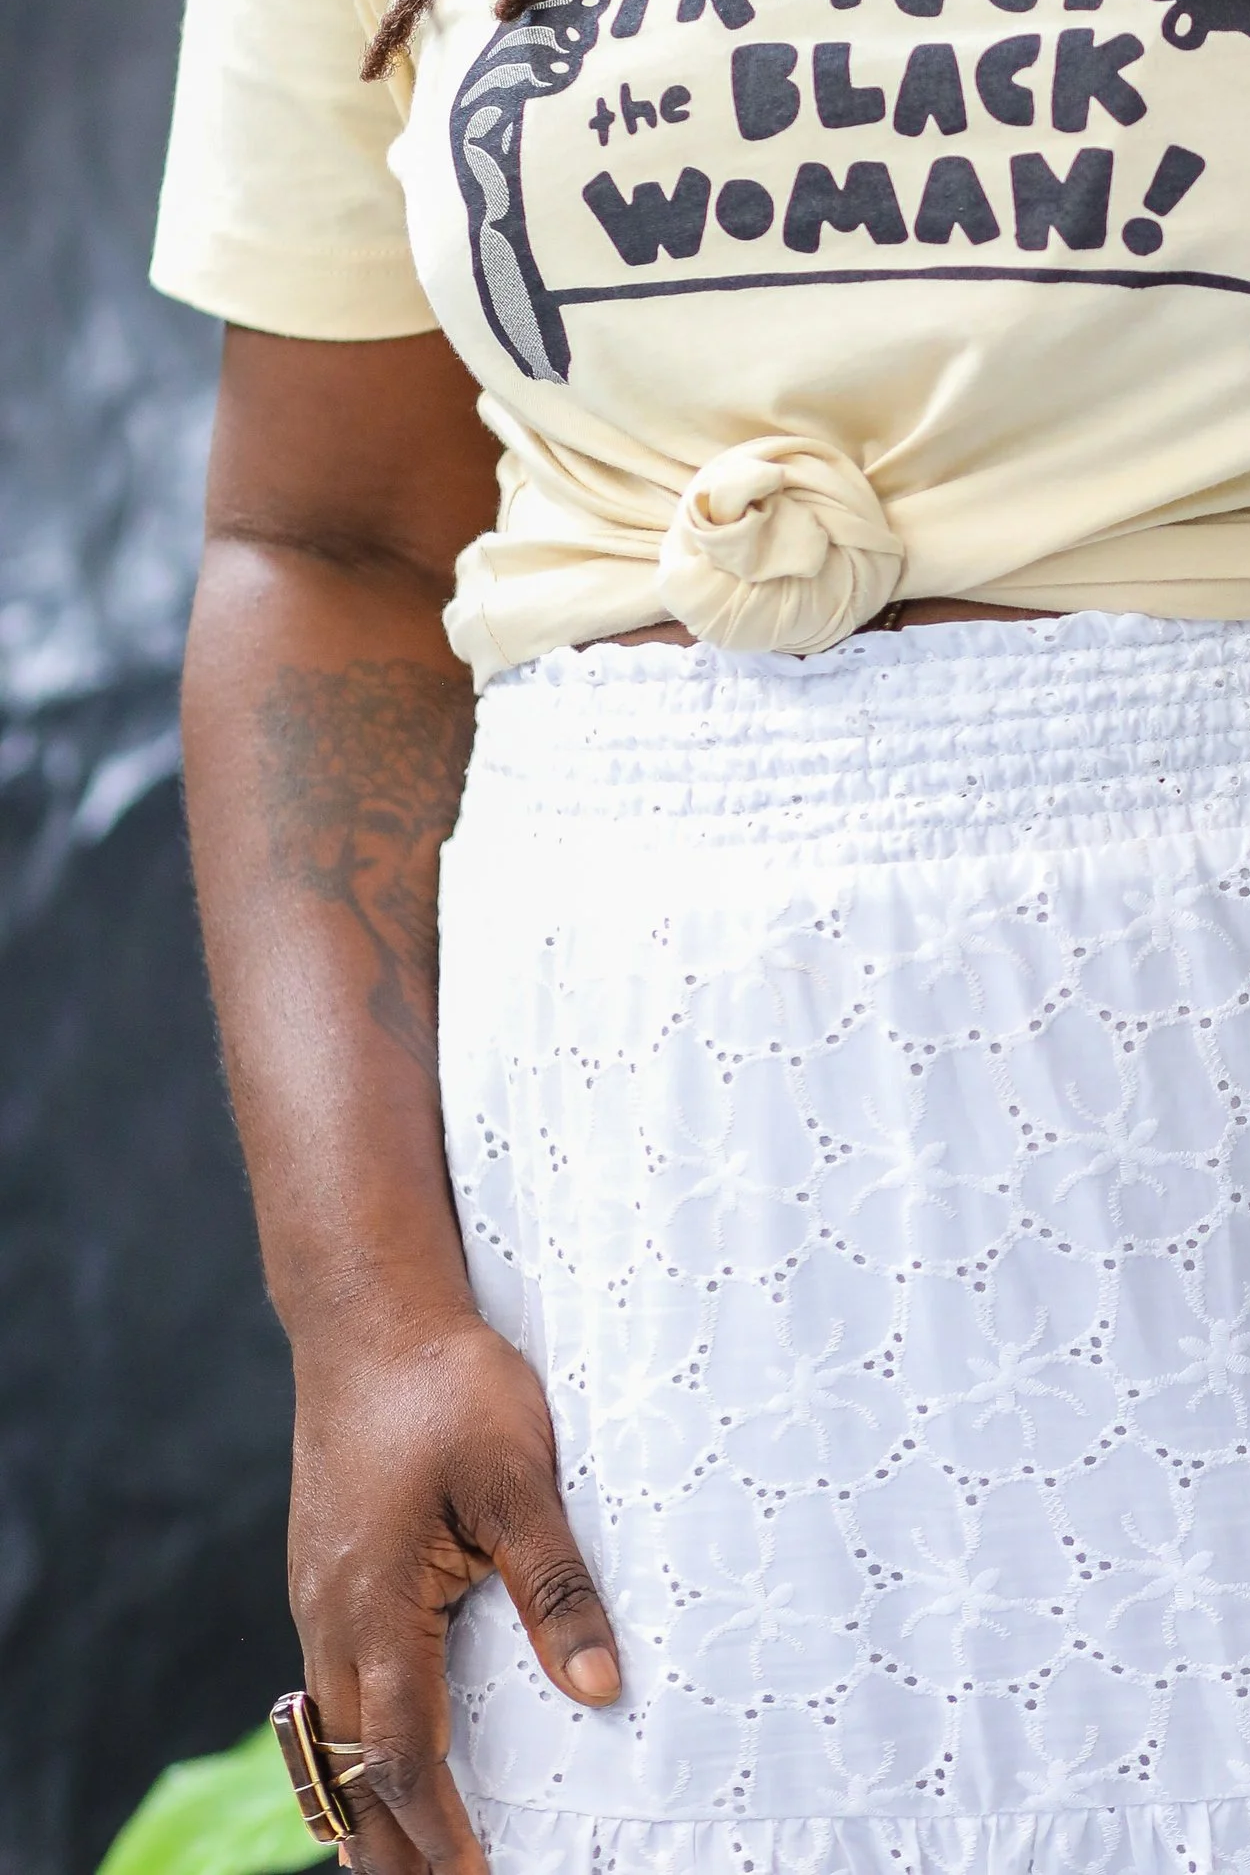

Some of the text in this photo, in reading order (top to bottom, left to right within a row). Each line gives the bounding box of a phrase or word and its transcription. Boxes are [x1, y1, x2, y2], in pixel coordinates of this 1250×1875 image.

[589, 28, 1148, 147] the BLACK
[582, 144, 1206, 267] WOMAN!
